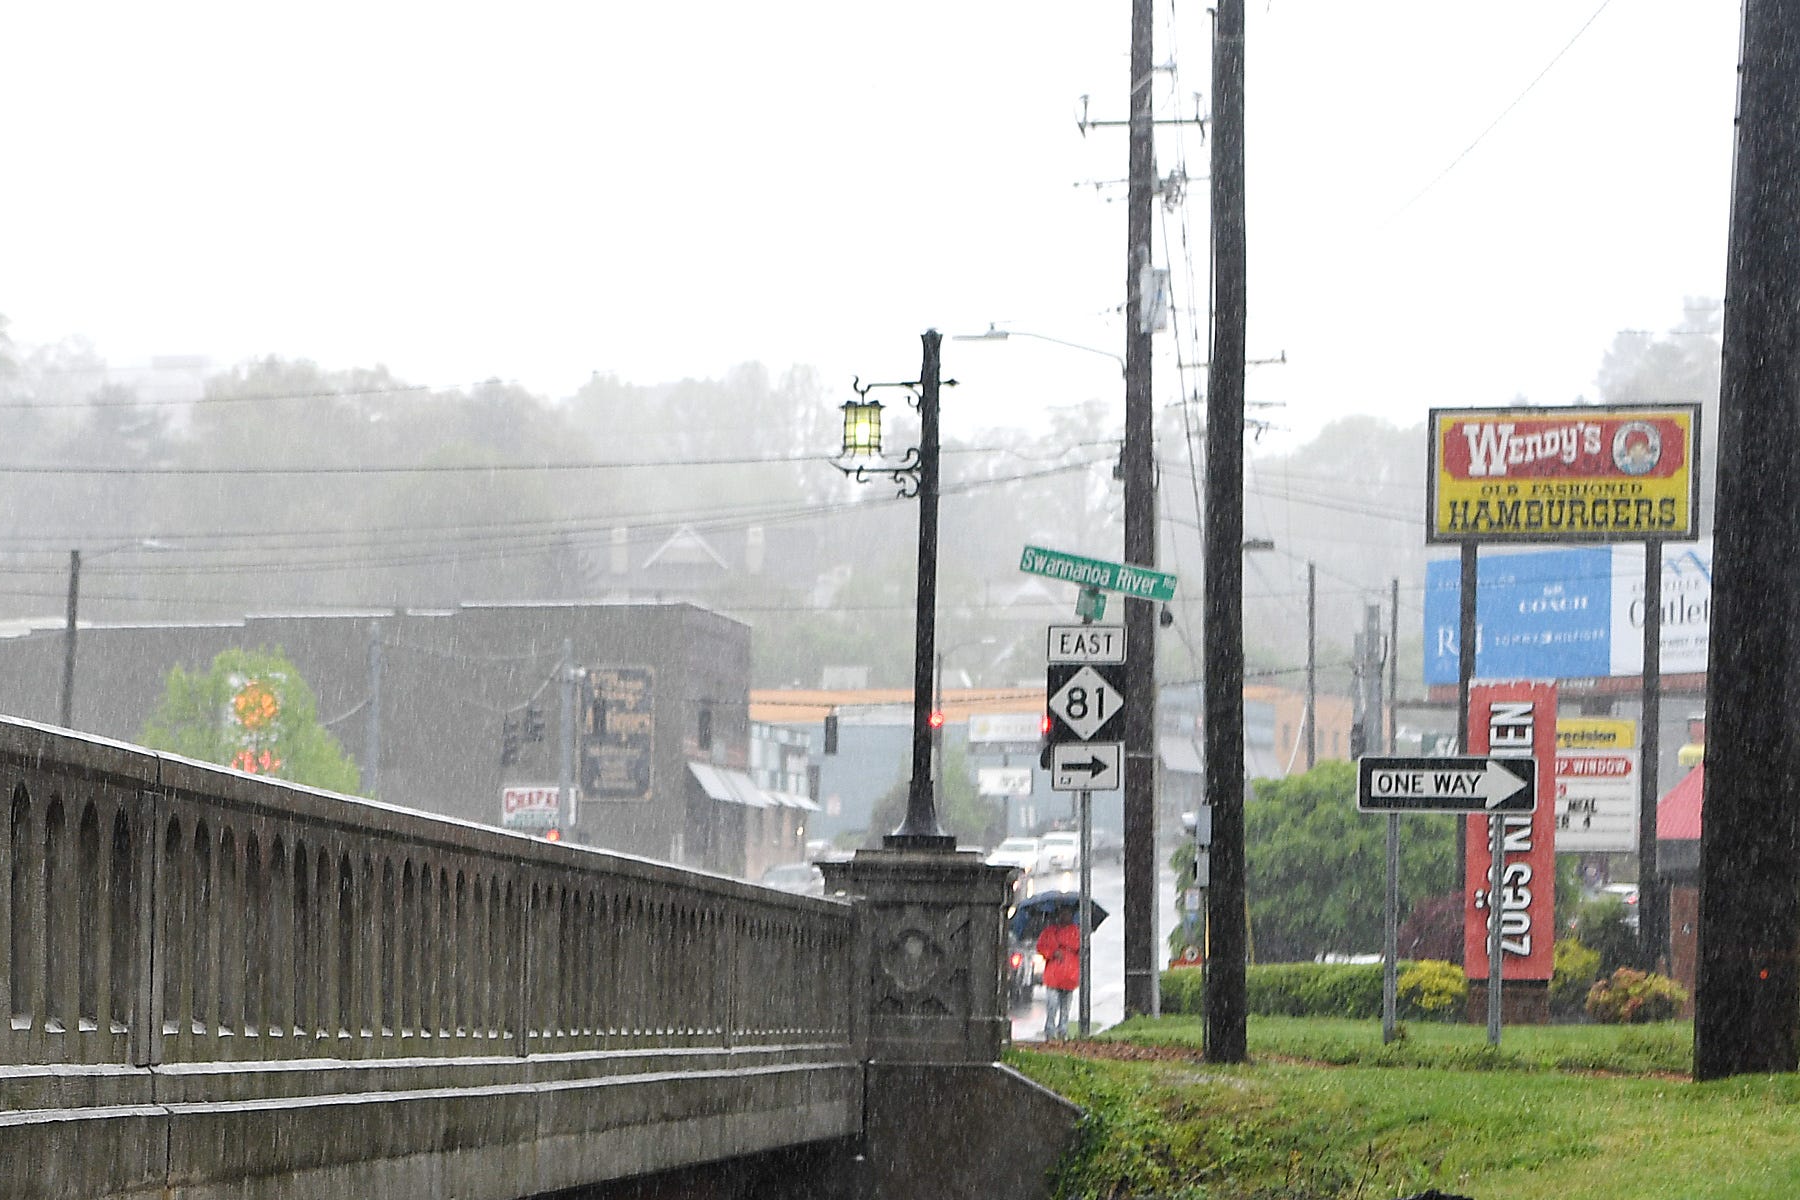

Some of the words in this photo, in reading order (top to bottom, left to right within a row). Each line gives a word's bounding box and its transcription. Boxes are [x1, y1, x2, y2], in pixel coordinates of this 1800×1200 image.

[1463, 422, 1602, 476] Wendy's
[1448, 498, 1676, 530] HAMBURGERS
[1022, 548, 1111, 587] Swannanoa
[1115, 564, 1158, 594] River
[1059, 634, 1114, 655] EAST
[1066, 686, 1105, 720] 81
[1556, 730, 1616, 746] recision
[1573, 758, 1626, 775] WINDOW
[1377, 774, 1424, 794] ONE
[1434, 774, 1481, 794] WAY
